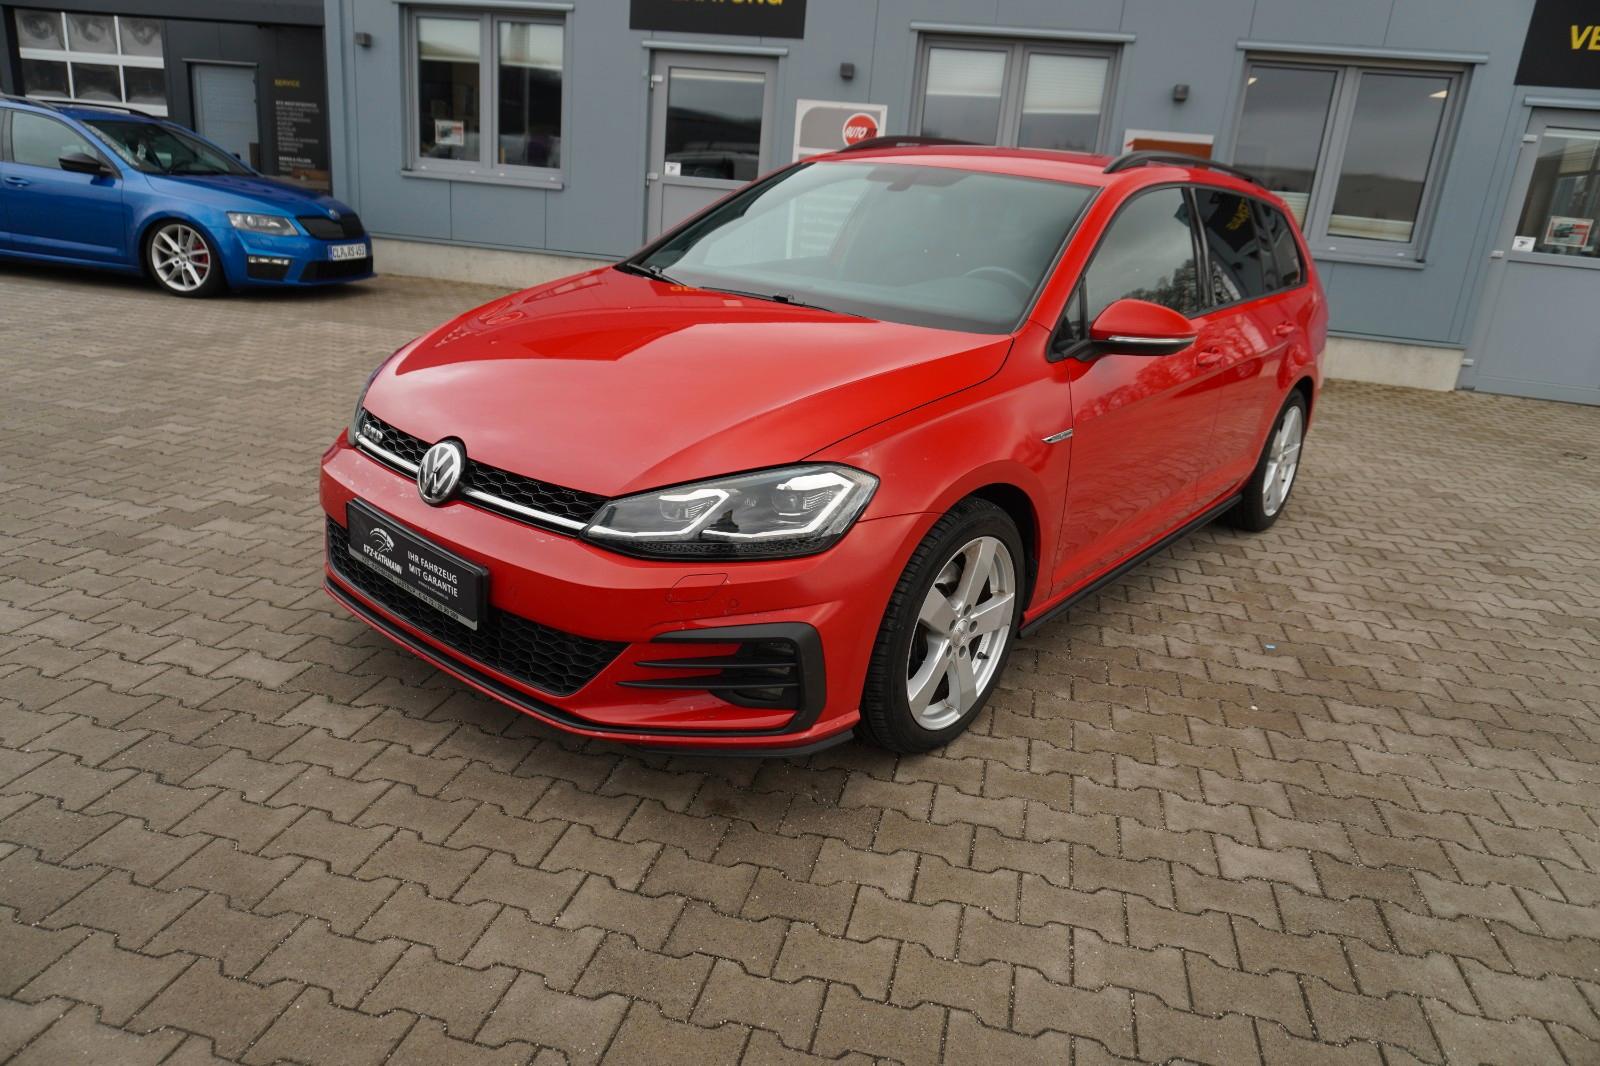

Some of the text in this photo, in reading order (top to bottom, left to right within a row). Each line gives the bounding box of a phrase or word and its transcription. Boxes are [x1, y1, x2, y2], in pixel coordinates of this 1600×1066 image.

[363, 543, 404, 575] KFZ-KATHMANN
[407, 550, 420, 564] IHR
[420, 557, 458, 585] FAHRZEUG
[408, 563, 422, 577] MIT
[422, 571, 459, 598] GARANTIE
